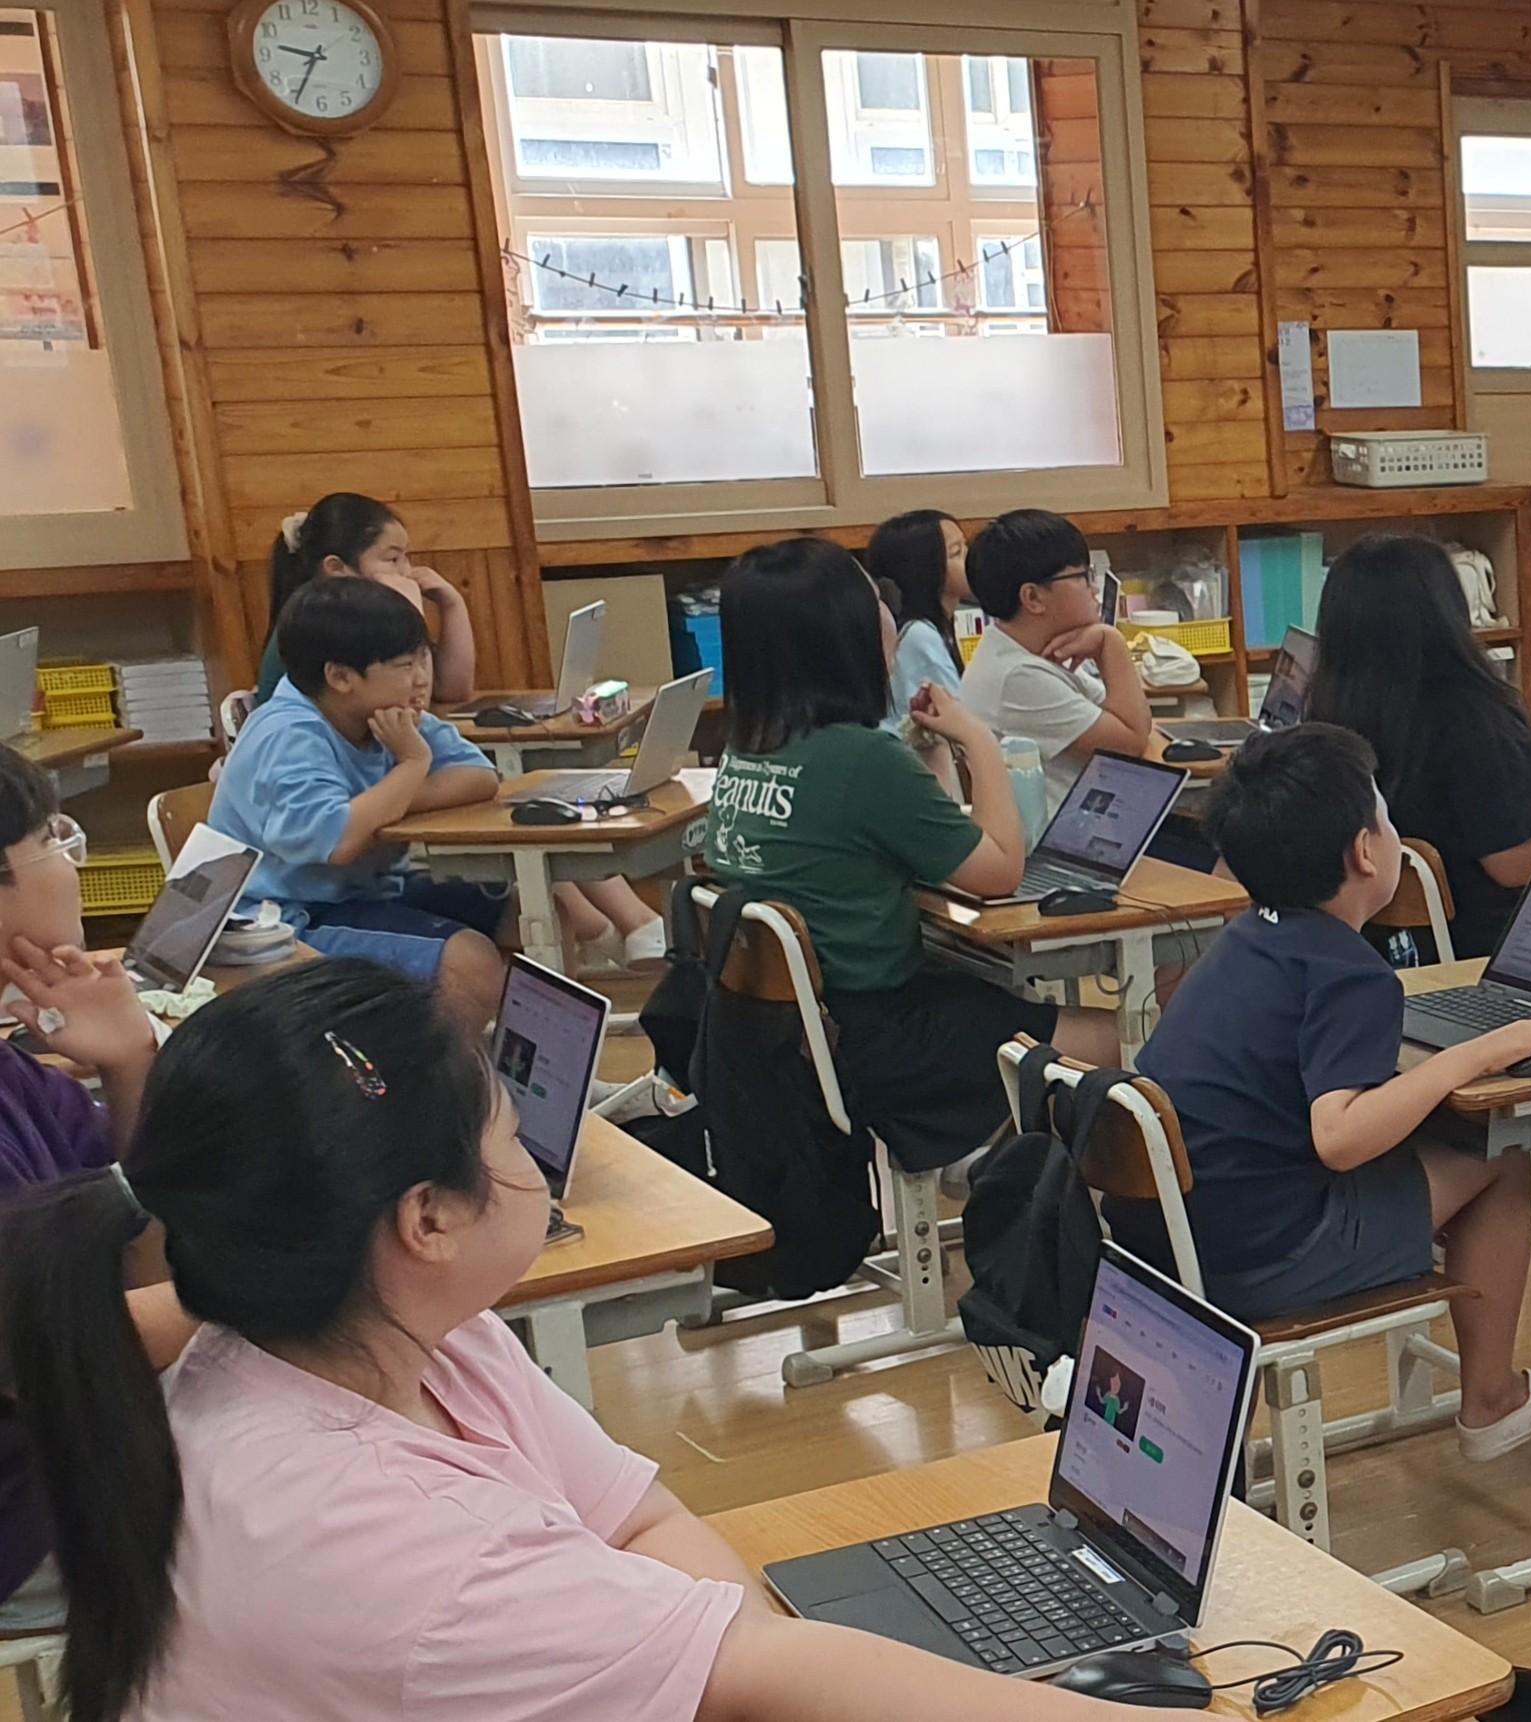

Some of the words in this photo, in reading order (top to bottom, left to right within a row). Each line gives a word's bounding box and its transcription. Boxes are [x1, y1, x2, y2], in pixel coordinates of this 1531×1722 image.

[278, 4, 292, 21] 11
[301, 0, 319, 15] 12
[330, 6, 339, 23] 1
[261, 22, 277, 38] 10
[348, 25, 361, 42] 2
[259, 47, 271, 63] 9
[359, 49, 371, 66] 3
[270, 71, 282, 86] 8
[316, 95, 328, 112] 6
[340, 91, 352, 107] 5
